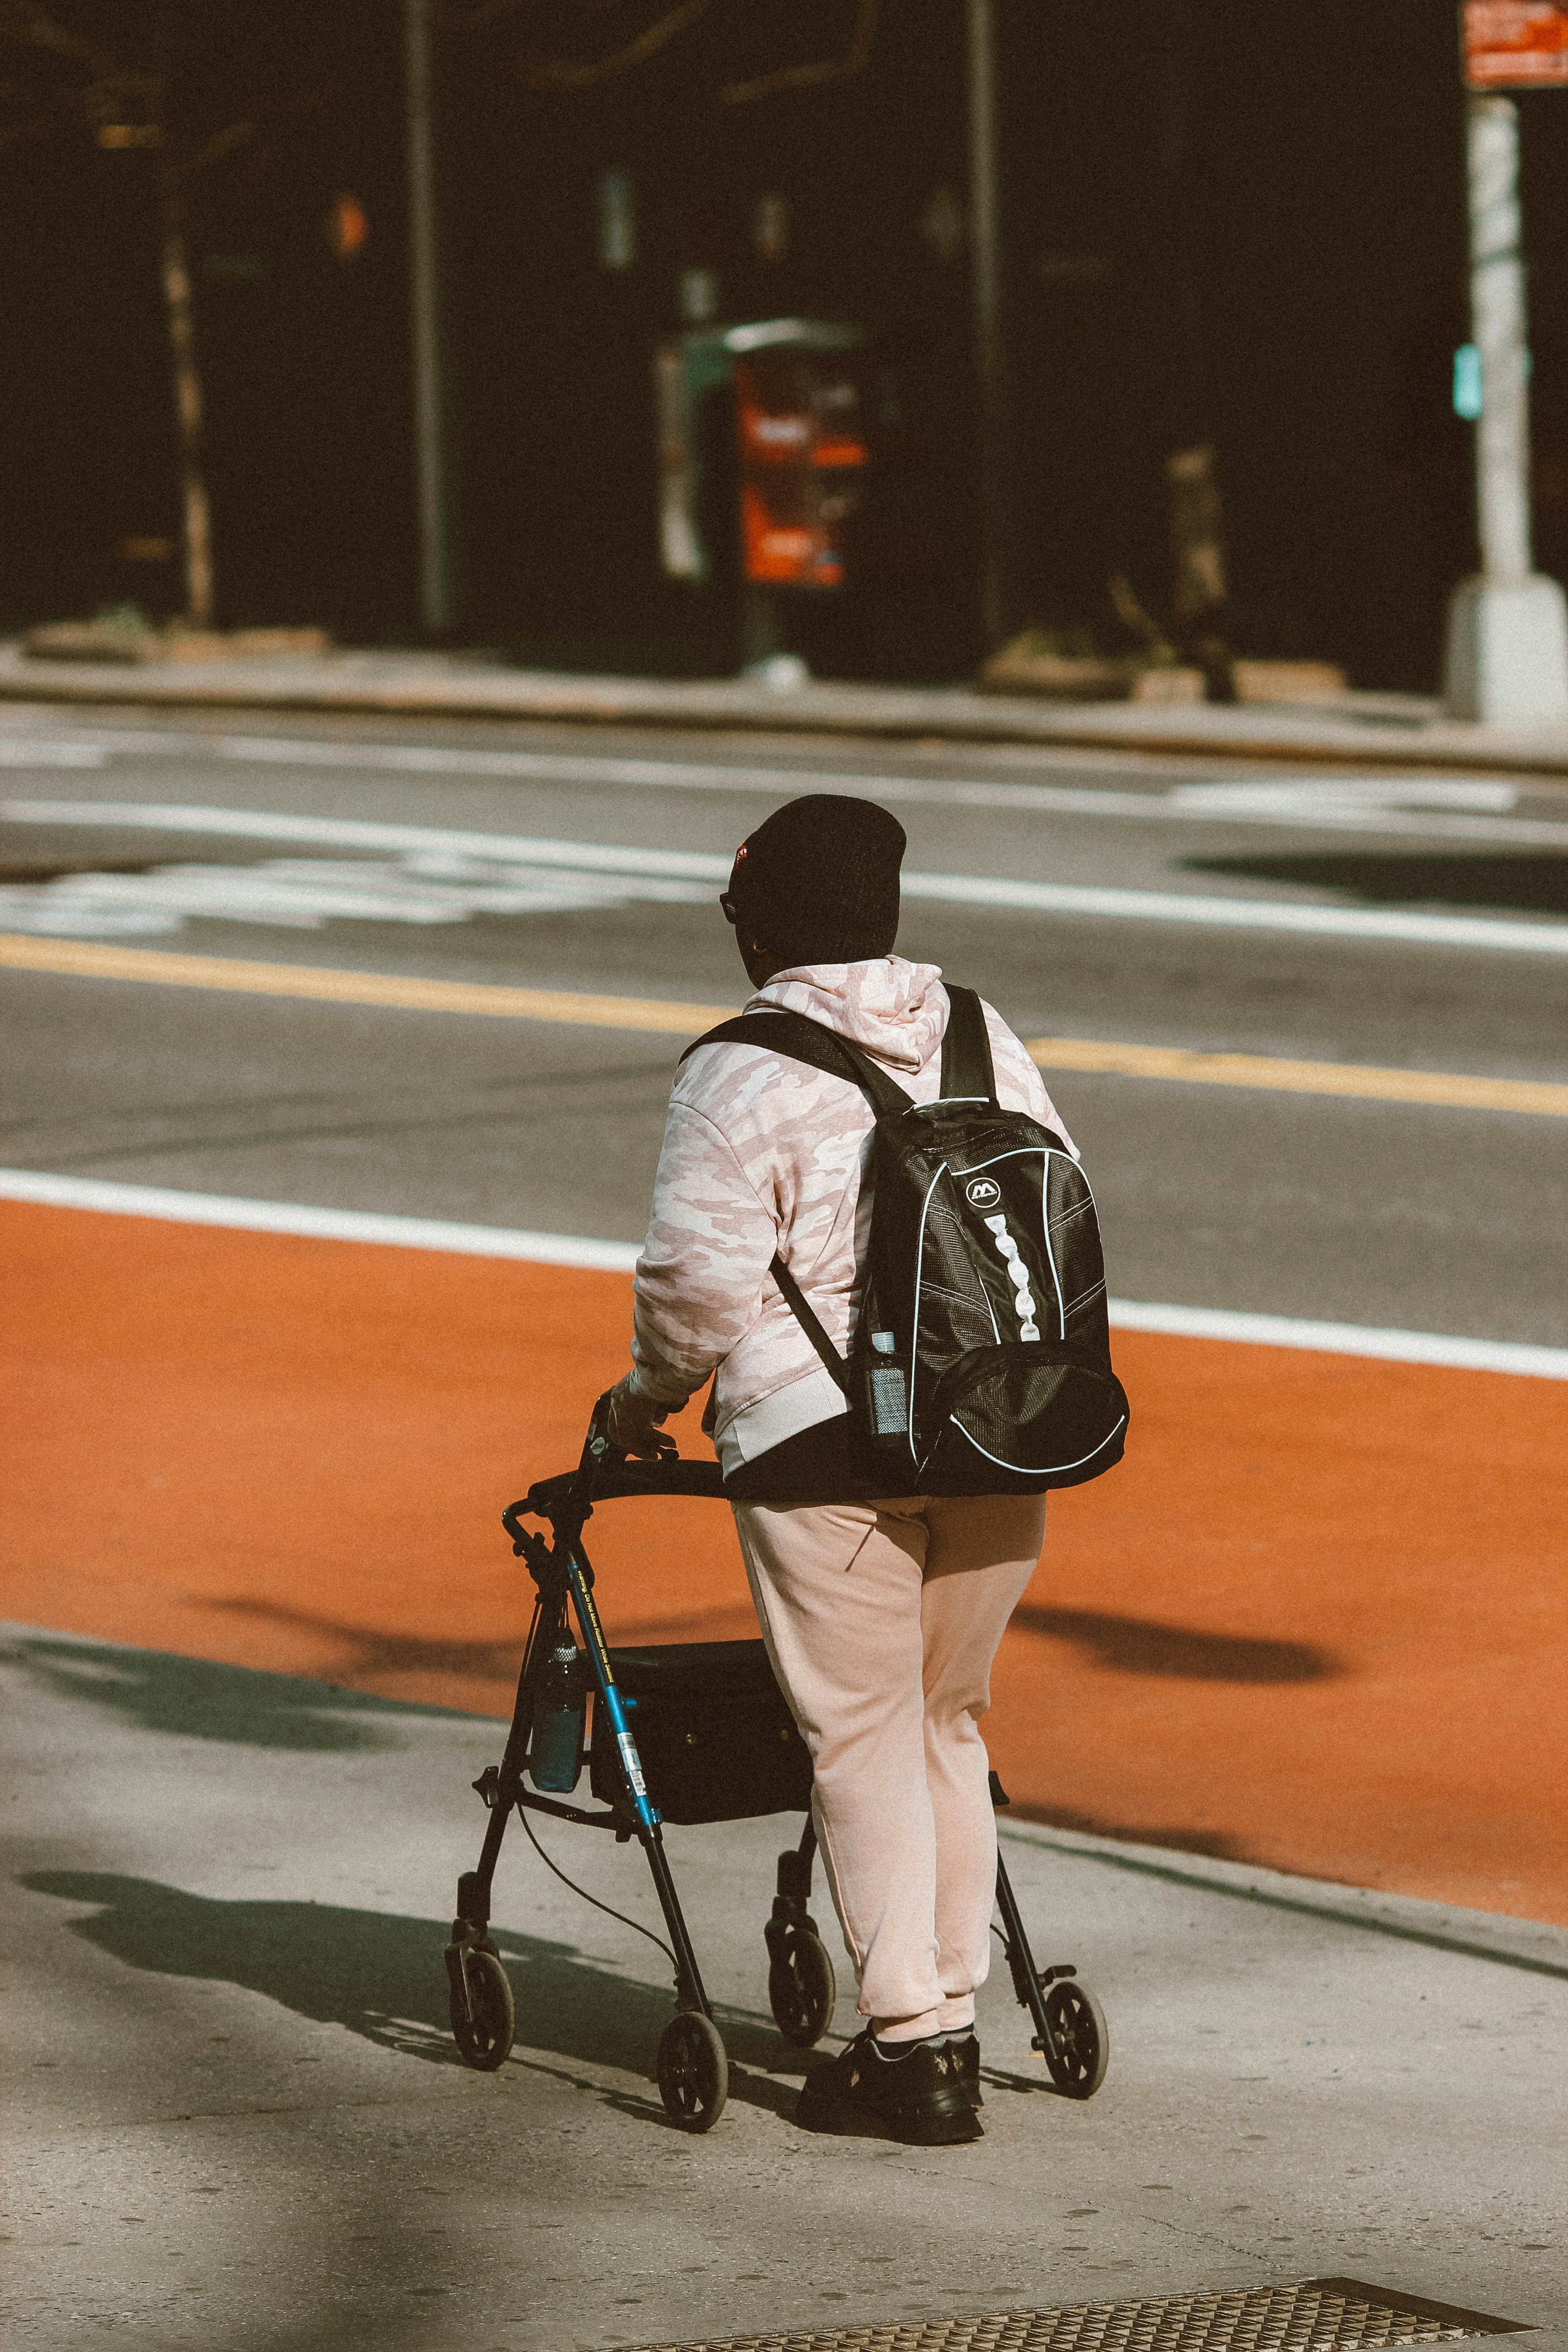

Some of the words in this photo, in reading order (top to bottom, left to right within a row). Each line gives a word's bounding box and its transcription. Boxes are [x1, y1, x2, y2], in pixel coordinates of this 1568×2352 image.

[584, 1594, 590, 1602] Do
[594, 1628, 603, 1647] Rollator
[605, 1664, 614, 1682] Seated
